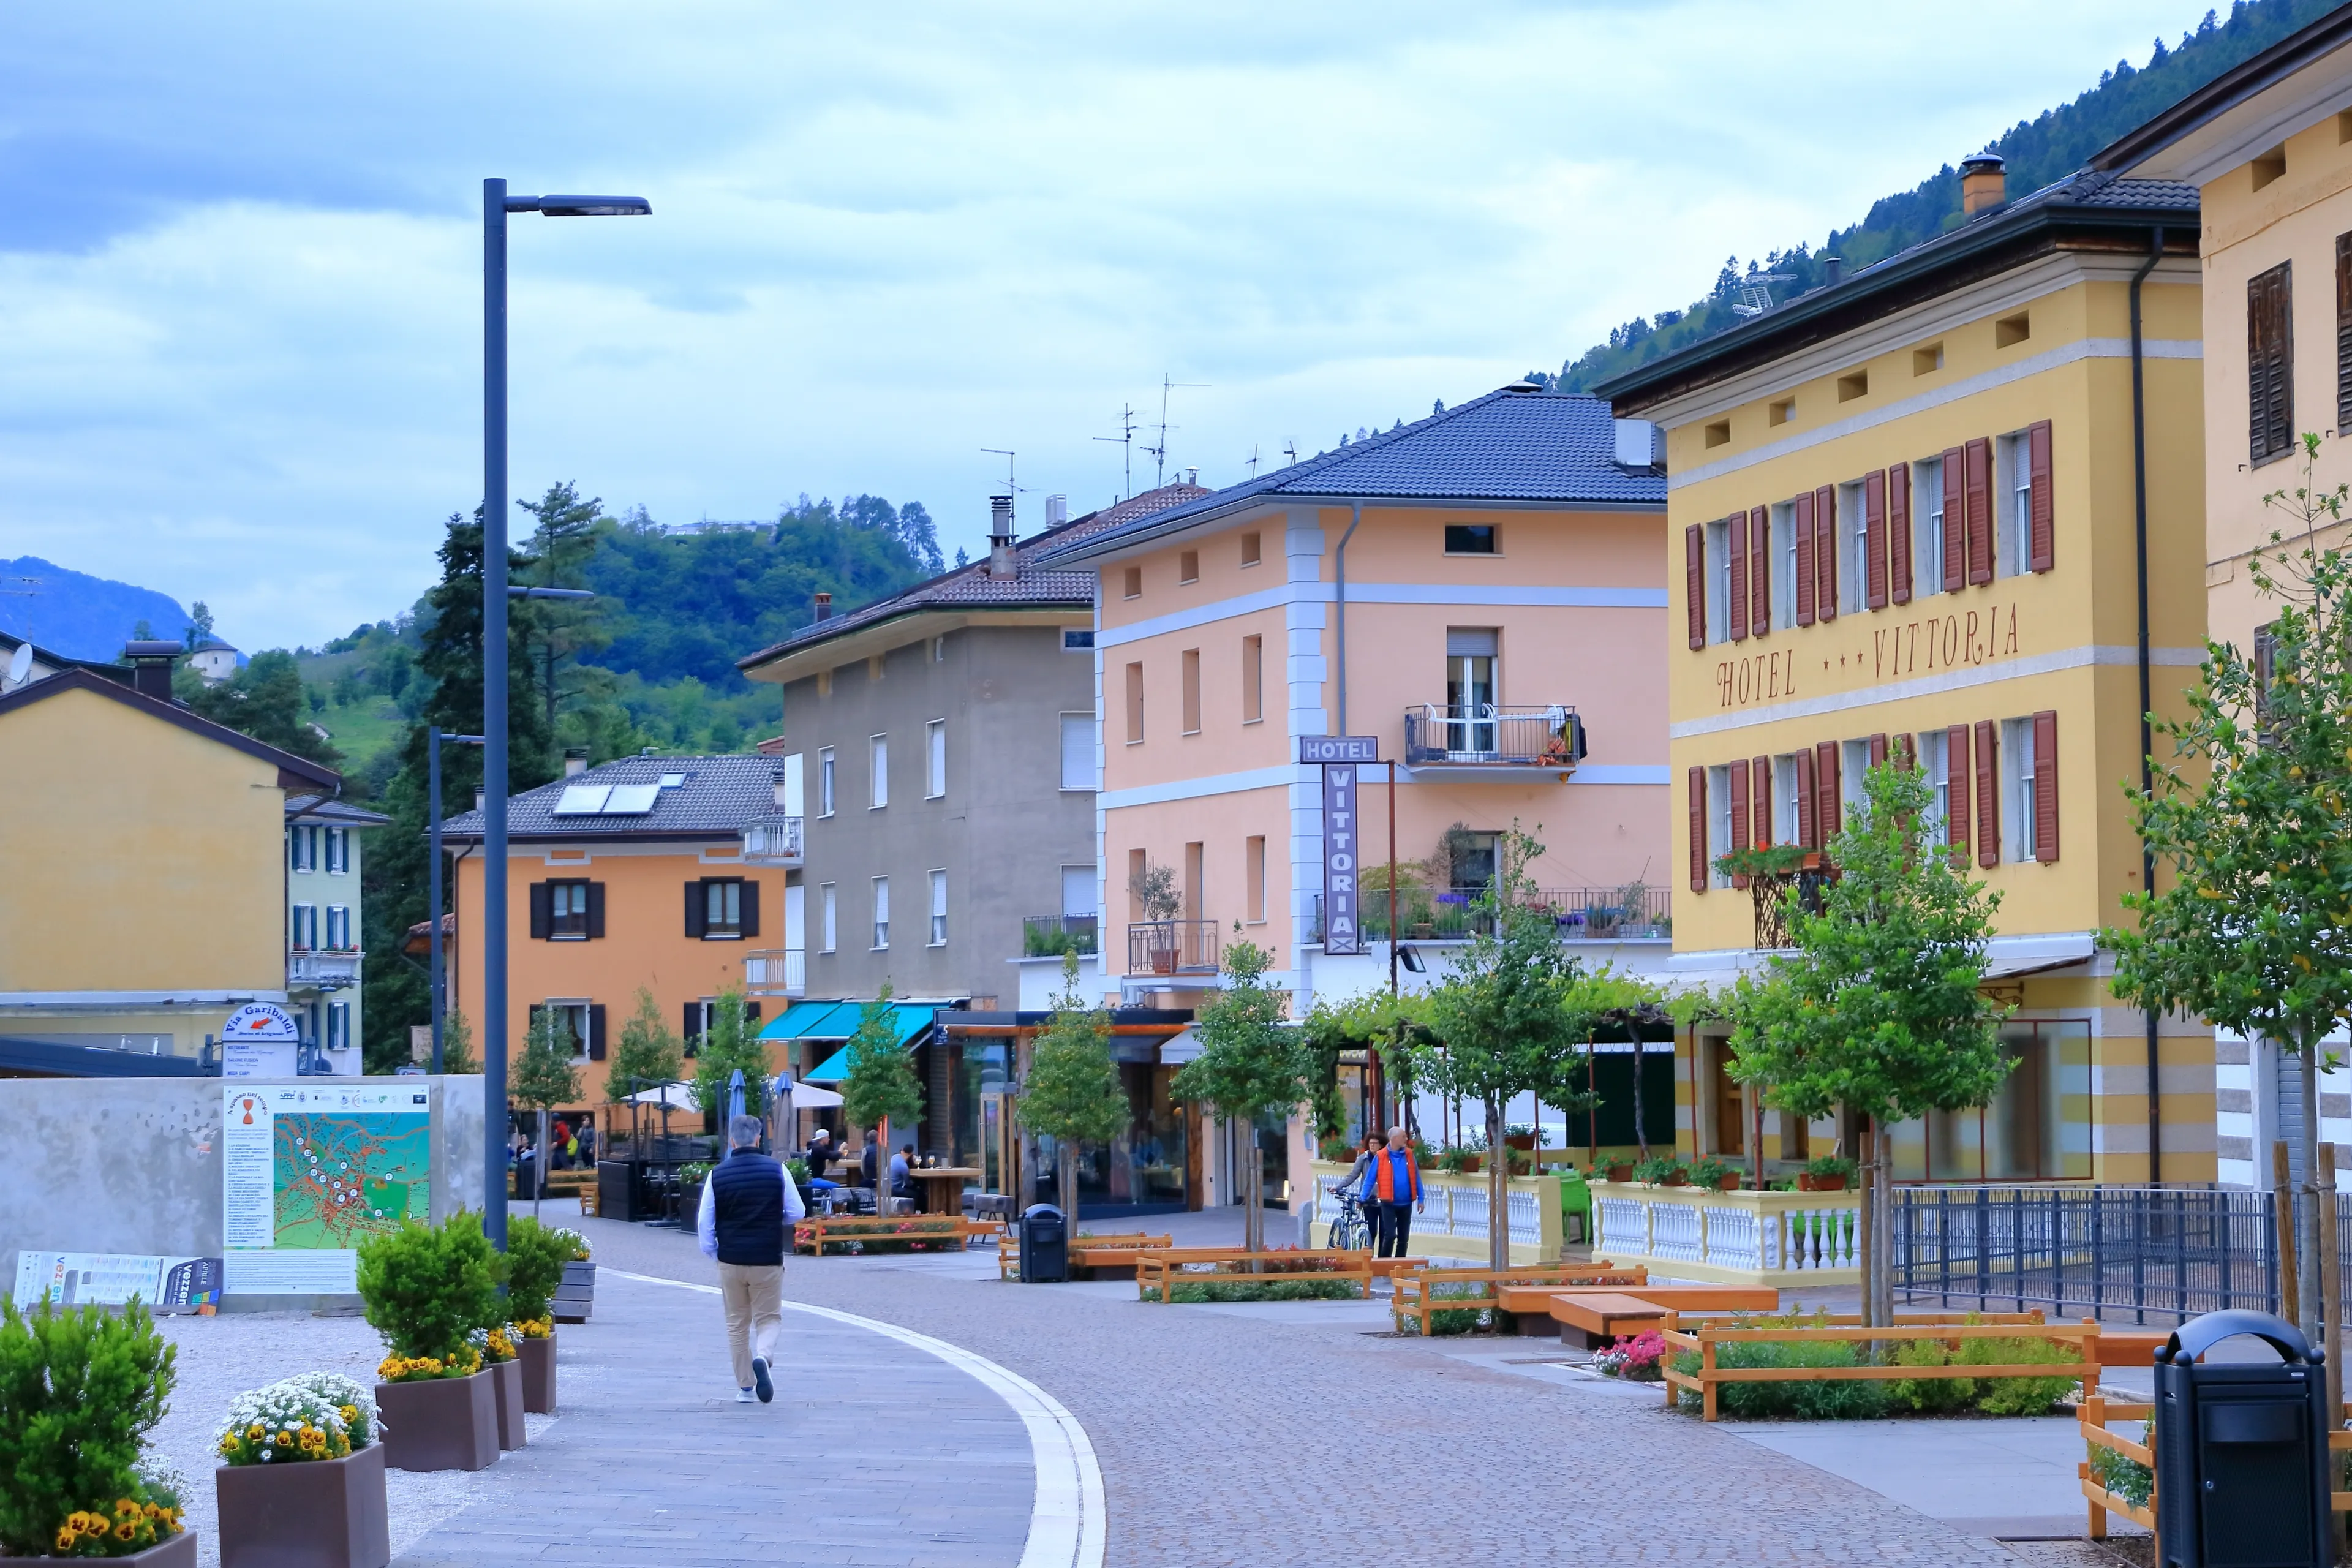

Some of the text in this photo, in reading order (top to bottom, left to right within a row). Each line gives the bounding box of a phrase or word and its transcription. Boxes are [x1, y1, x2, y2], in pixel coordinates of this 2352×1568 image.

[1717, 603, 2018, 707] HOTEL VITTORIA
[1306, 742, 1373, 758] HOTEL
[1330, 770, 1354, 933] VITTORIA
[225, 1006, 295, 1034] Via Garibaldi
[230, 1093, 246, 1109] spasso
[257, 1094, 268, 1115] tempo
[200, 1262, 209, 1285] APRILE
